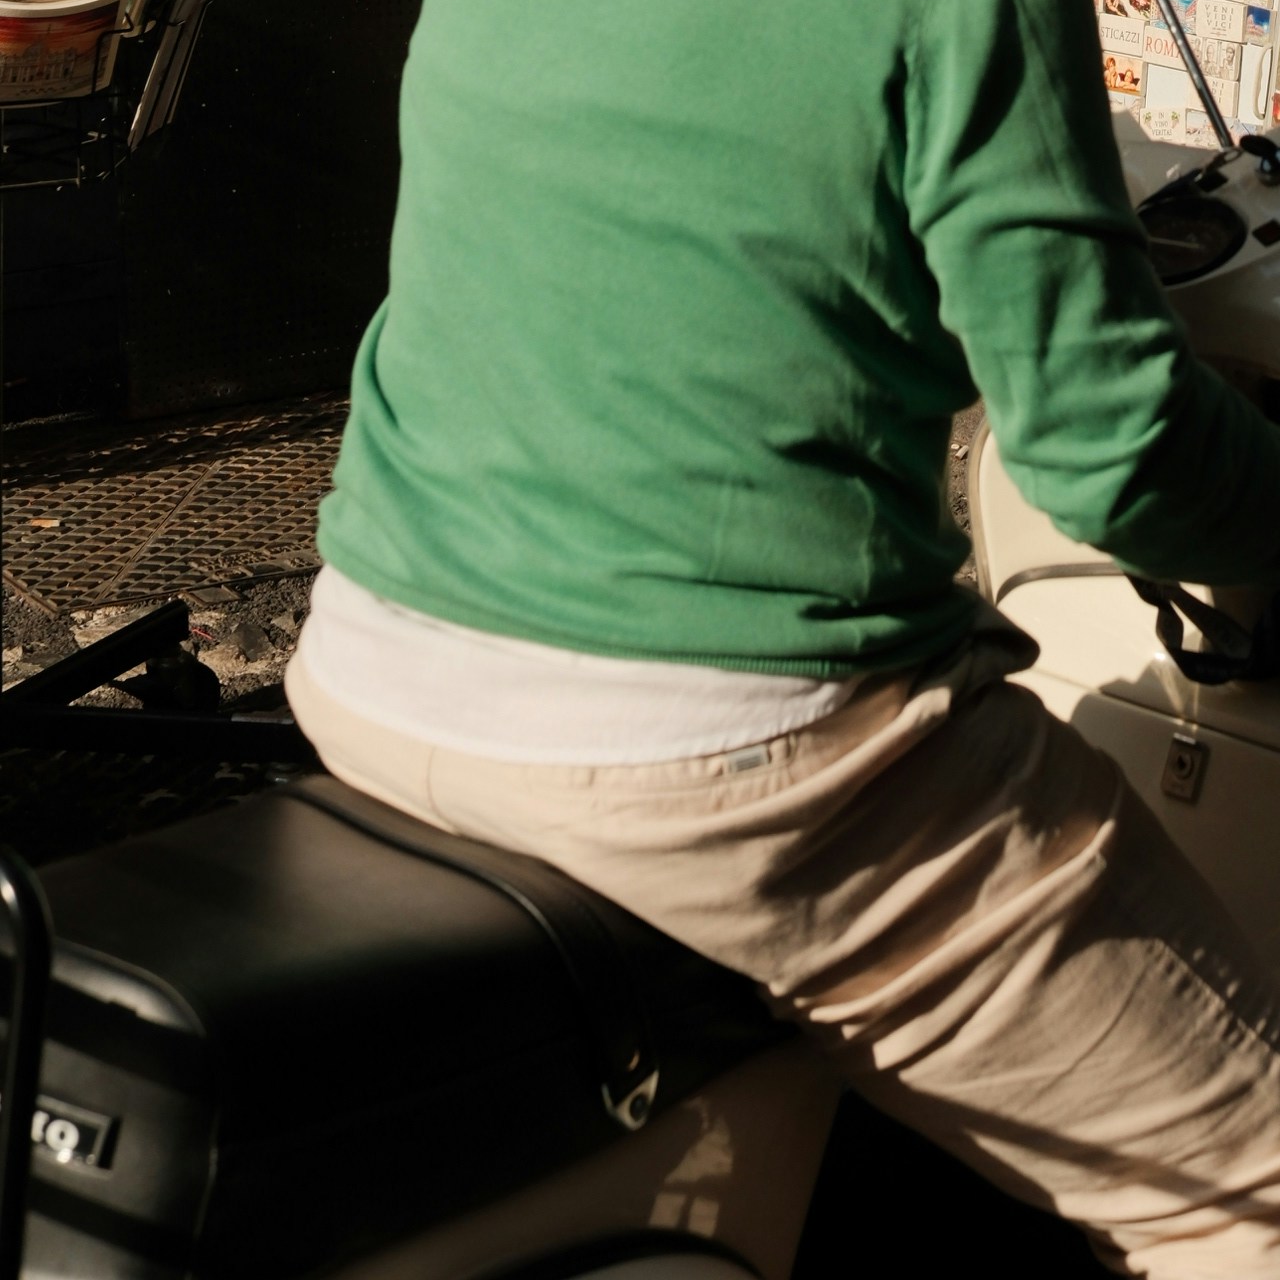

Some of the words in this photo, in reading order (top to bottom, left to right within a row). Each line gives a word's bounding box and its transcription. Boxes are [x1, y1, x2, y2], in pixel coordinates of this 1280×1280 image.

[1205, 4, 1234, 14] VENI
[1205, 12, 1232, 21] VIDI
[1206, 20, 1232, 30] VICI
[1100, 28, 1140, 44] STICAZZI
[1158, 112, 1166, 120] IN
[1155, 120, 1169, 128] VINO
[1152, 128, 1173, 138] VERITAS
